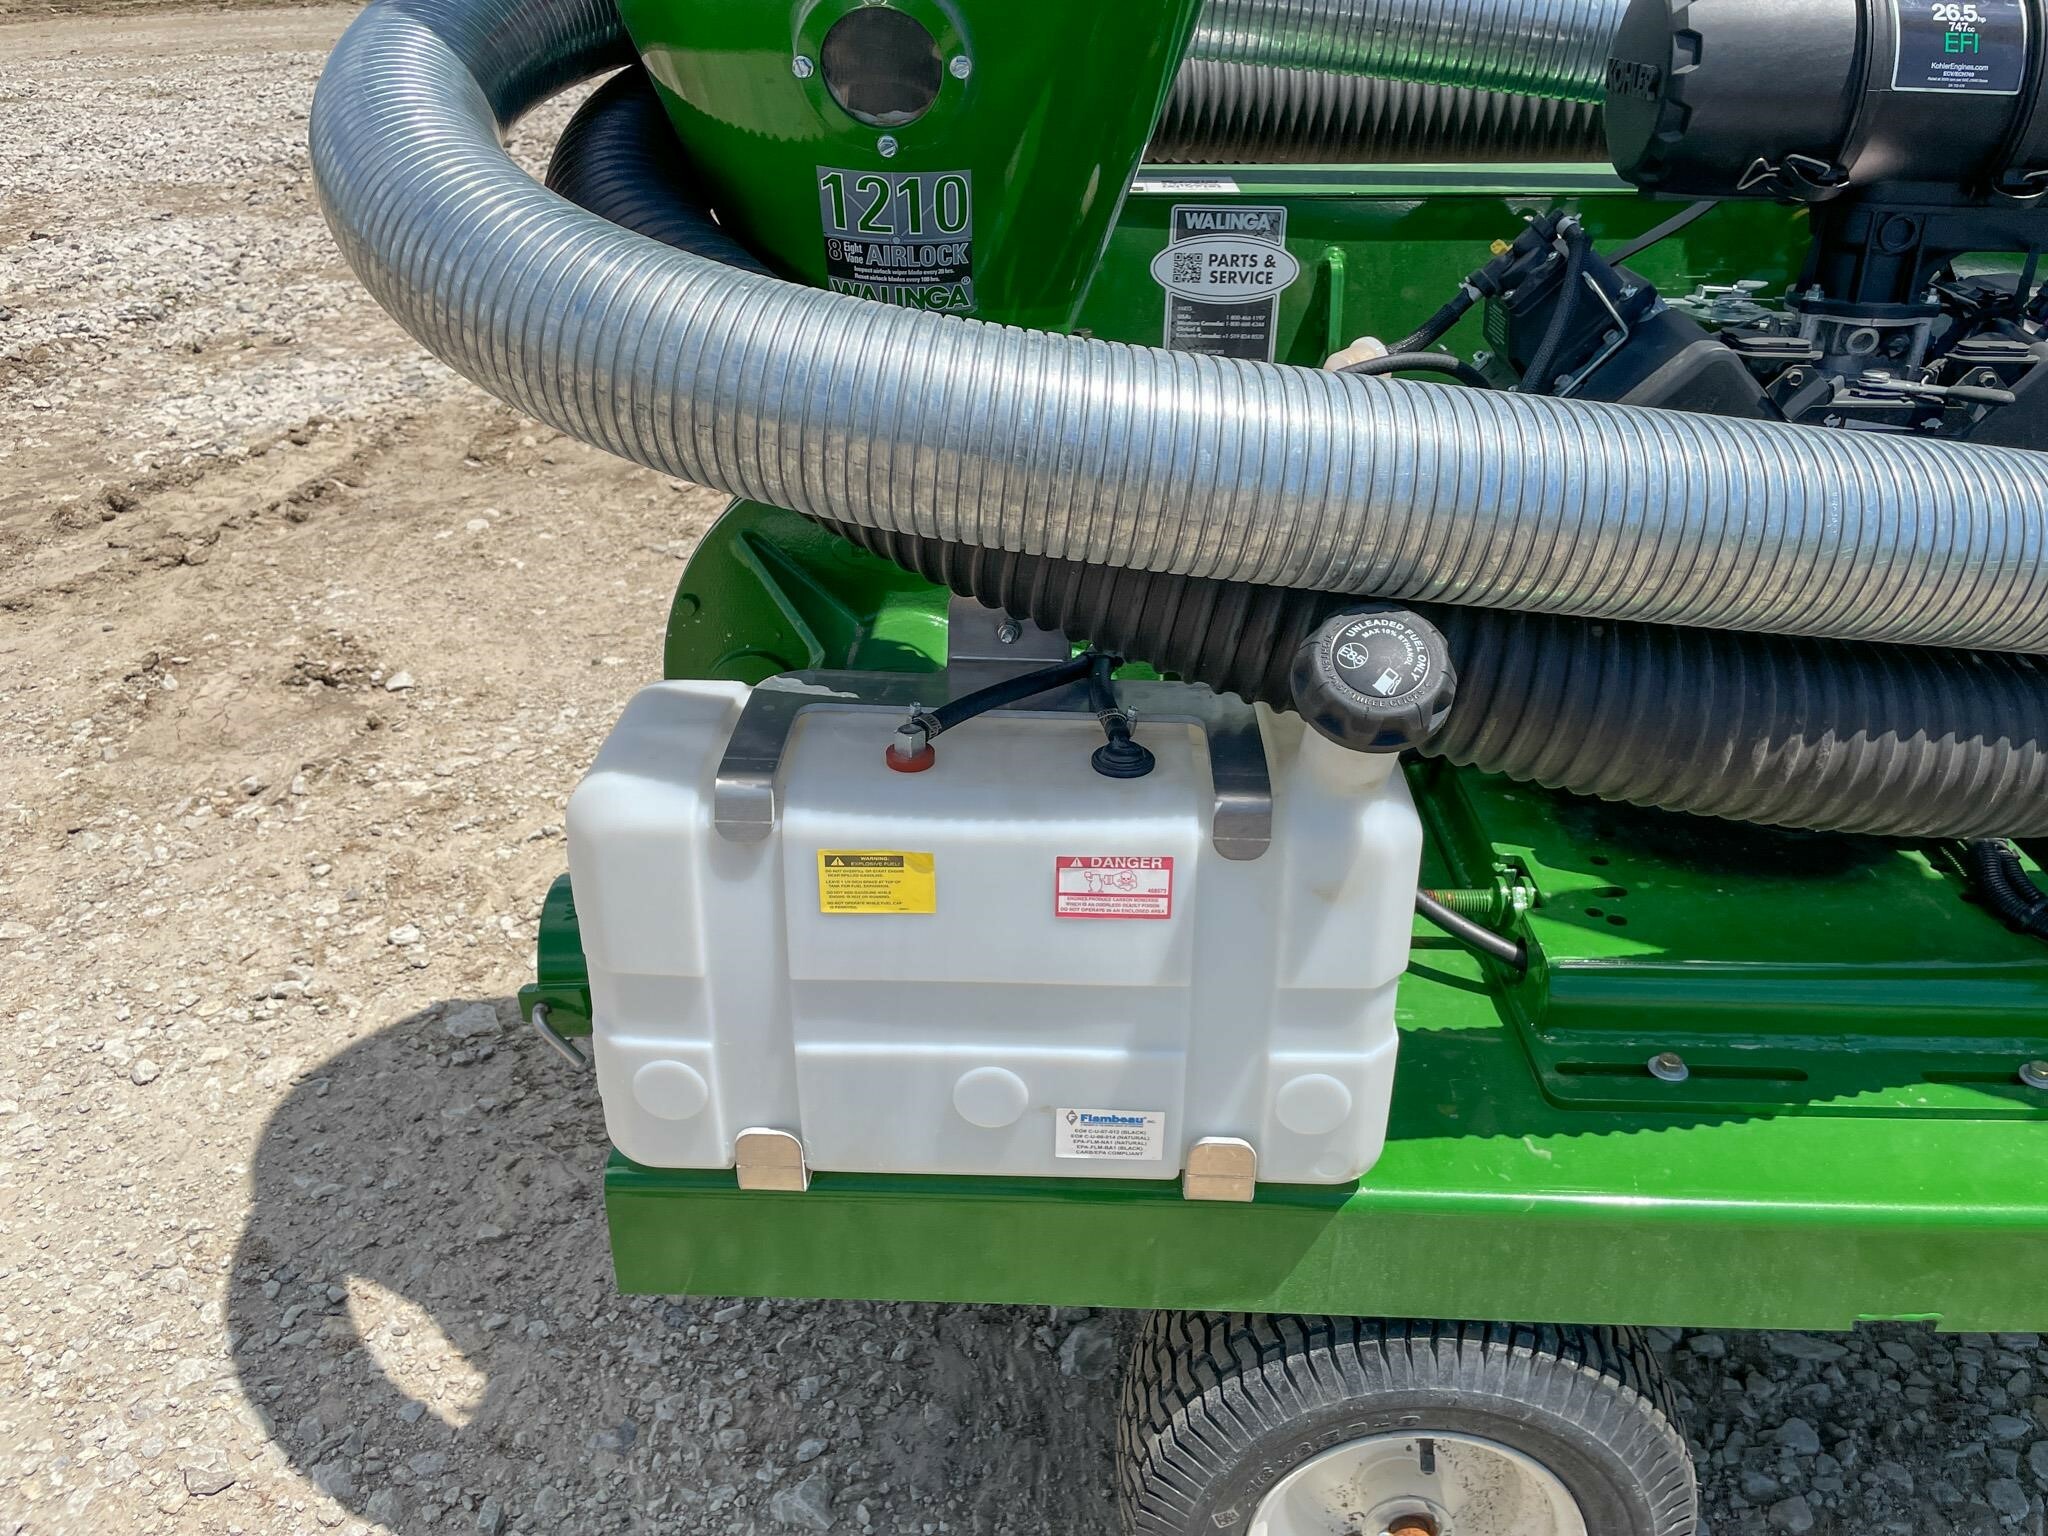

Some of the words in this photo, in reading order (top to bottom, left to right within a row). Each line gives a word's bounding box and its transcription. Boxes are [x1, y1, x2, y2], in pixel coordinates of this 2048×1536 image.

[1945, 32, 1979, 53] EFI
[1931, 62, 1989, 72] KohlerEngines.com
[820, 172, 969, 235] 1210
[1185, 212, 1271, 231] WALINGA
[828, 239, 842, 260] 8
[843, 241, 863, 254] Eight
[866, 242, 969, 268] AIRLOCK
[844, 252, 863, 264] Vane
[1208, 254, 1258, 268] PARTS
[1263, 255, 1276, 268] &
[1209, 270, 1273, 284] SERVICE
[1346, 619, 1404, 637] UNLEADED
[1362, 628, 1380, 638] MAX
[1382, 628, 1397, 637] 10%
[1397, 634, 1414, 665] ETHANOL
[1405, 629, 1425, 652] FUEL
[1339, 645, 1366, 665] E85
[1411, 654, 1427, 681] ONLY
[1091, 857, 1162, 868] DANGER
[1080, 1113, 1144, 1124] Flambeau
